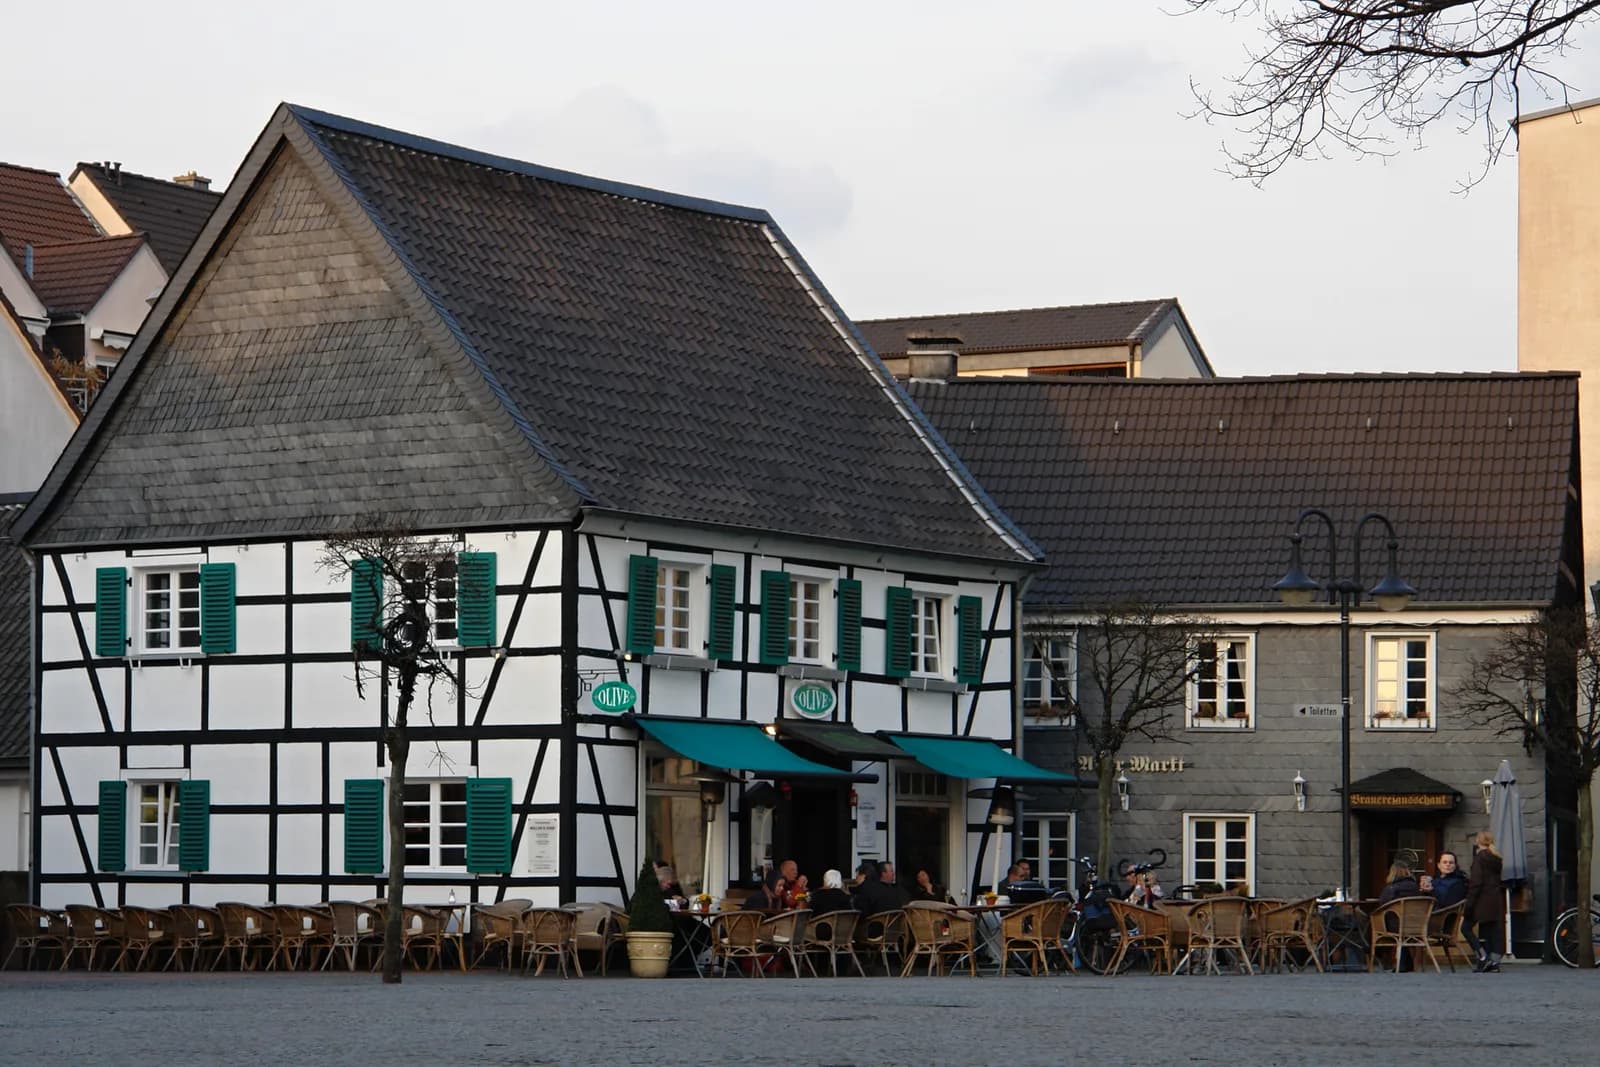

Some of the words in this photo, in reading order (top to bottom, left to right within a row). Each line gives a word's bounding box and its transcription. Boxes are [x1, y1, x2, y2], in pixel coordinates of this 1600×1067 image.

[598, 687, 631, 707] OLIVE
[799, 689, 829, 711] OLIVE
[1129, 755, 1184, 772] Markt
